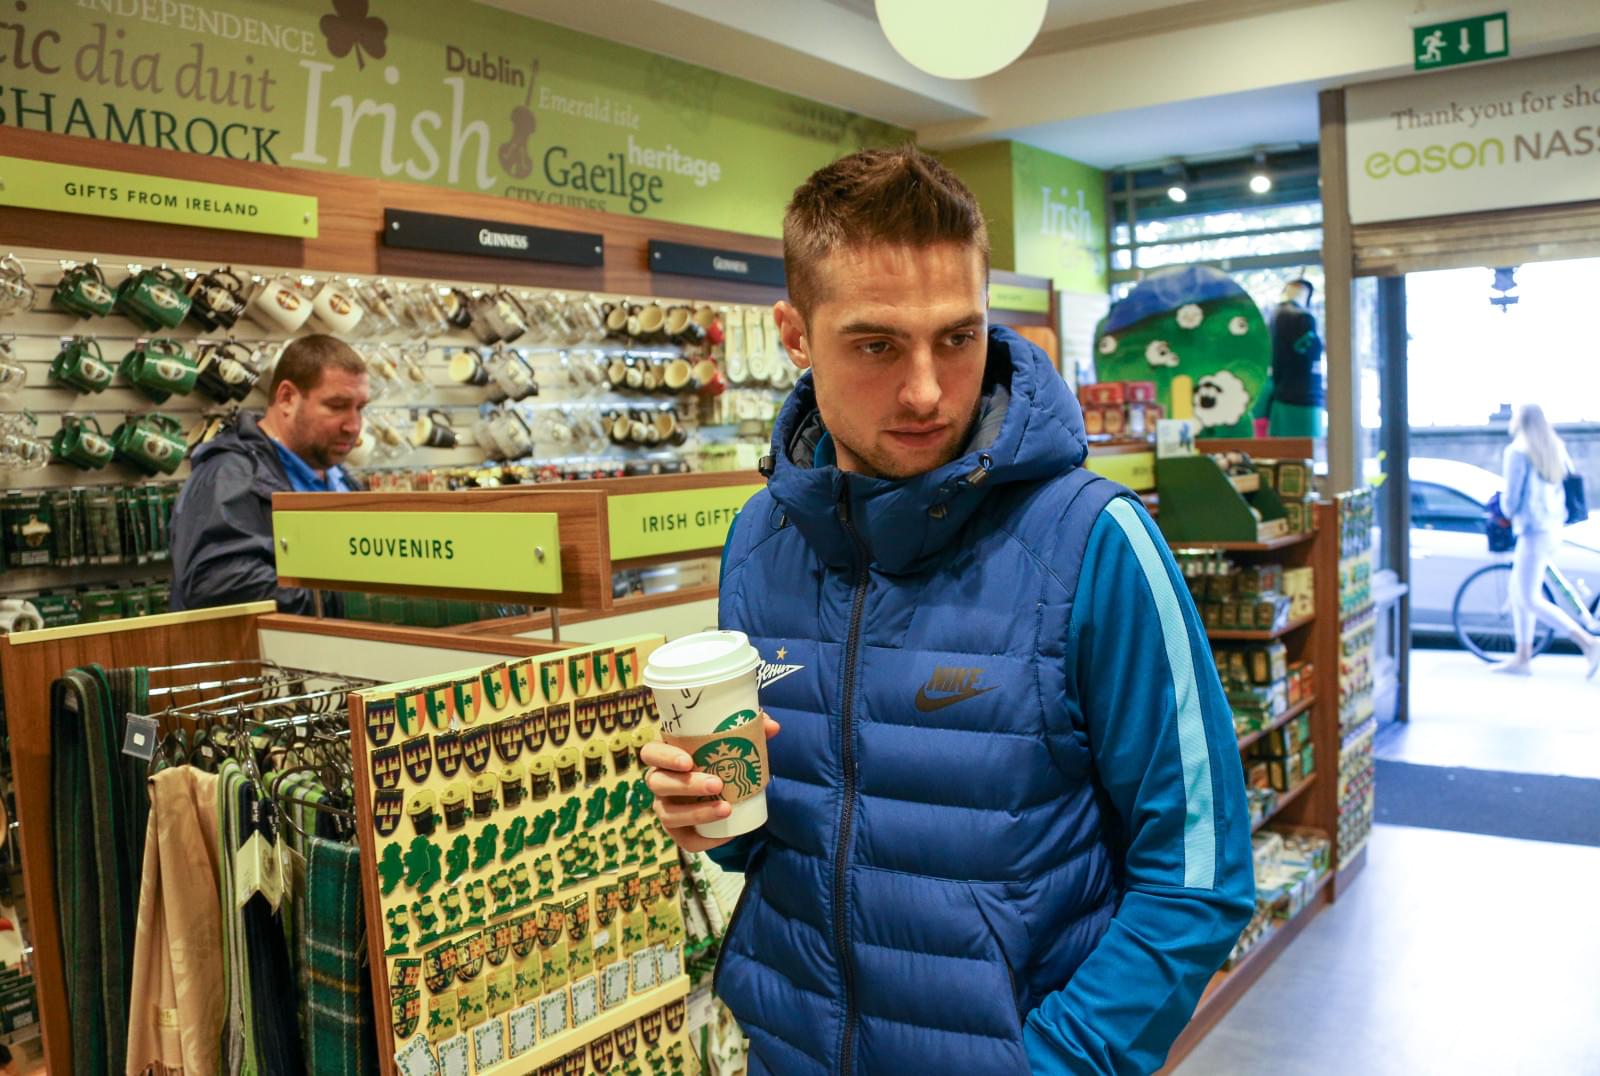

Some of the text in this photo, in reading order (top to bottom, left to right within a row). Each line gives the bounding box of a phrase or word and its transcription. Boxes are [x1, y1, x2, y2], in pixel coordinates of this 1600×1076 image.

[75, 22, 278, 113] dia duit
[446, 46, 524, 88] Dublin
[290, 60, 497, 190] Irish
[539, 87, 640, 131] Emerald isle
[1391, 102, 1464, 130] Thank
[1468, 101, 1513, 128] you
[1521, 91, 1556, 114] for
[627, 135, 721, 187] heritage
[1365, 138, 1505, 180] eason
[65, 183, 259, 217] GIFTS FROM IRELAND
[543, 146, 664, 215] Gaeilge
[479, 228, 528, 250] GUINNESS
[642, 512, 688, 533] IRISH
[349, 537, 455, 560] SOUVENIRS
[926, 664, 985, 691] NIKE
